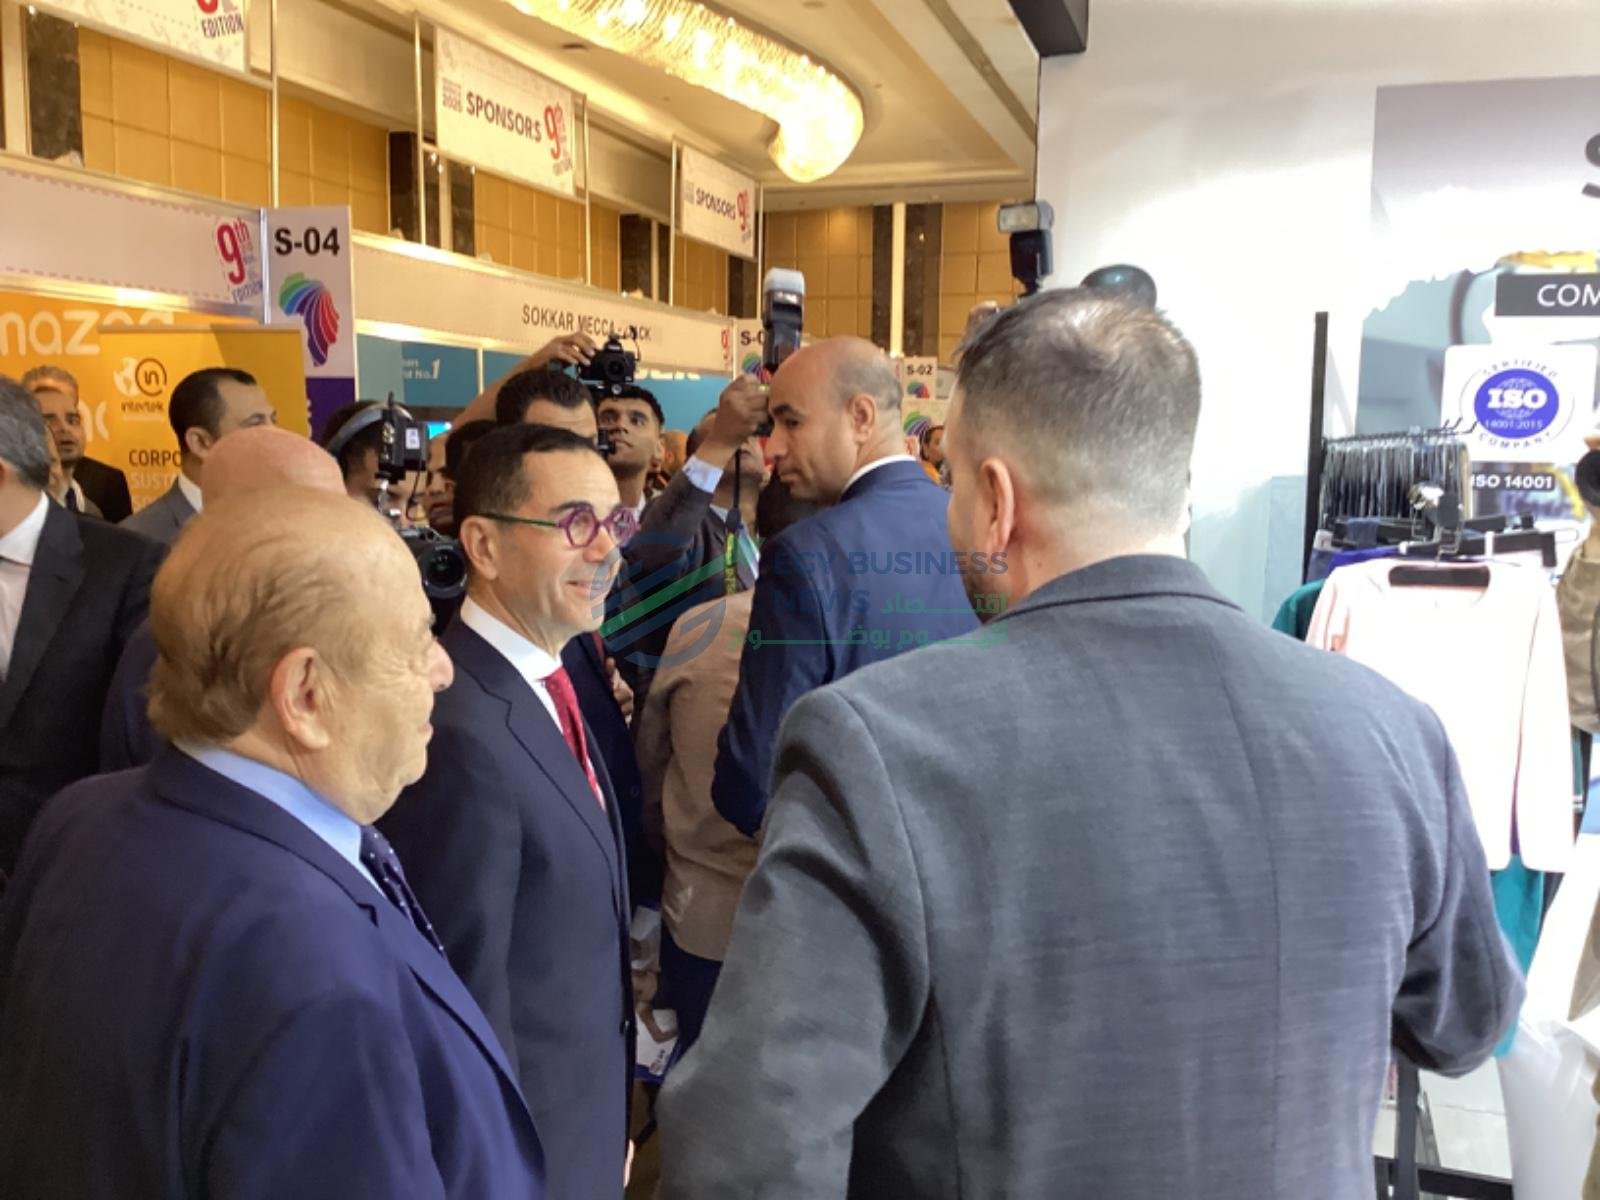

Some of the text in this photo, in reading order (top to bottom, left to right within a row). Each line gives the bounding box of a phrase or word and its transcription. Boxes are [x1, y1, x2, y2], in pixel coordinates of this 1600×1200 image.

[466, 91, 542, 143] SPONSORS
[696, 187, 736, 220] SPONSORS
[274, 227, 340, 256] S-04
[522, 303, 574, 331] SOKKAR
[740, 330, 768, 346] S-0
[1487, 388, 1548, 410] ISO
[1504, 475, 1553, 489] 14001
